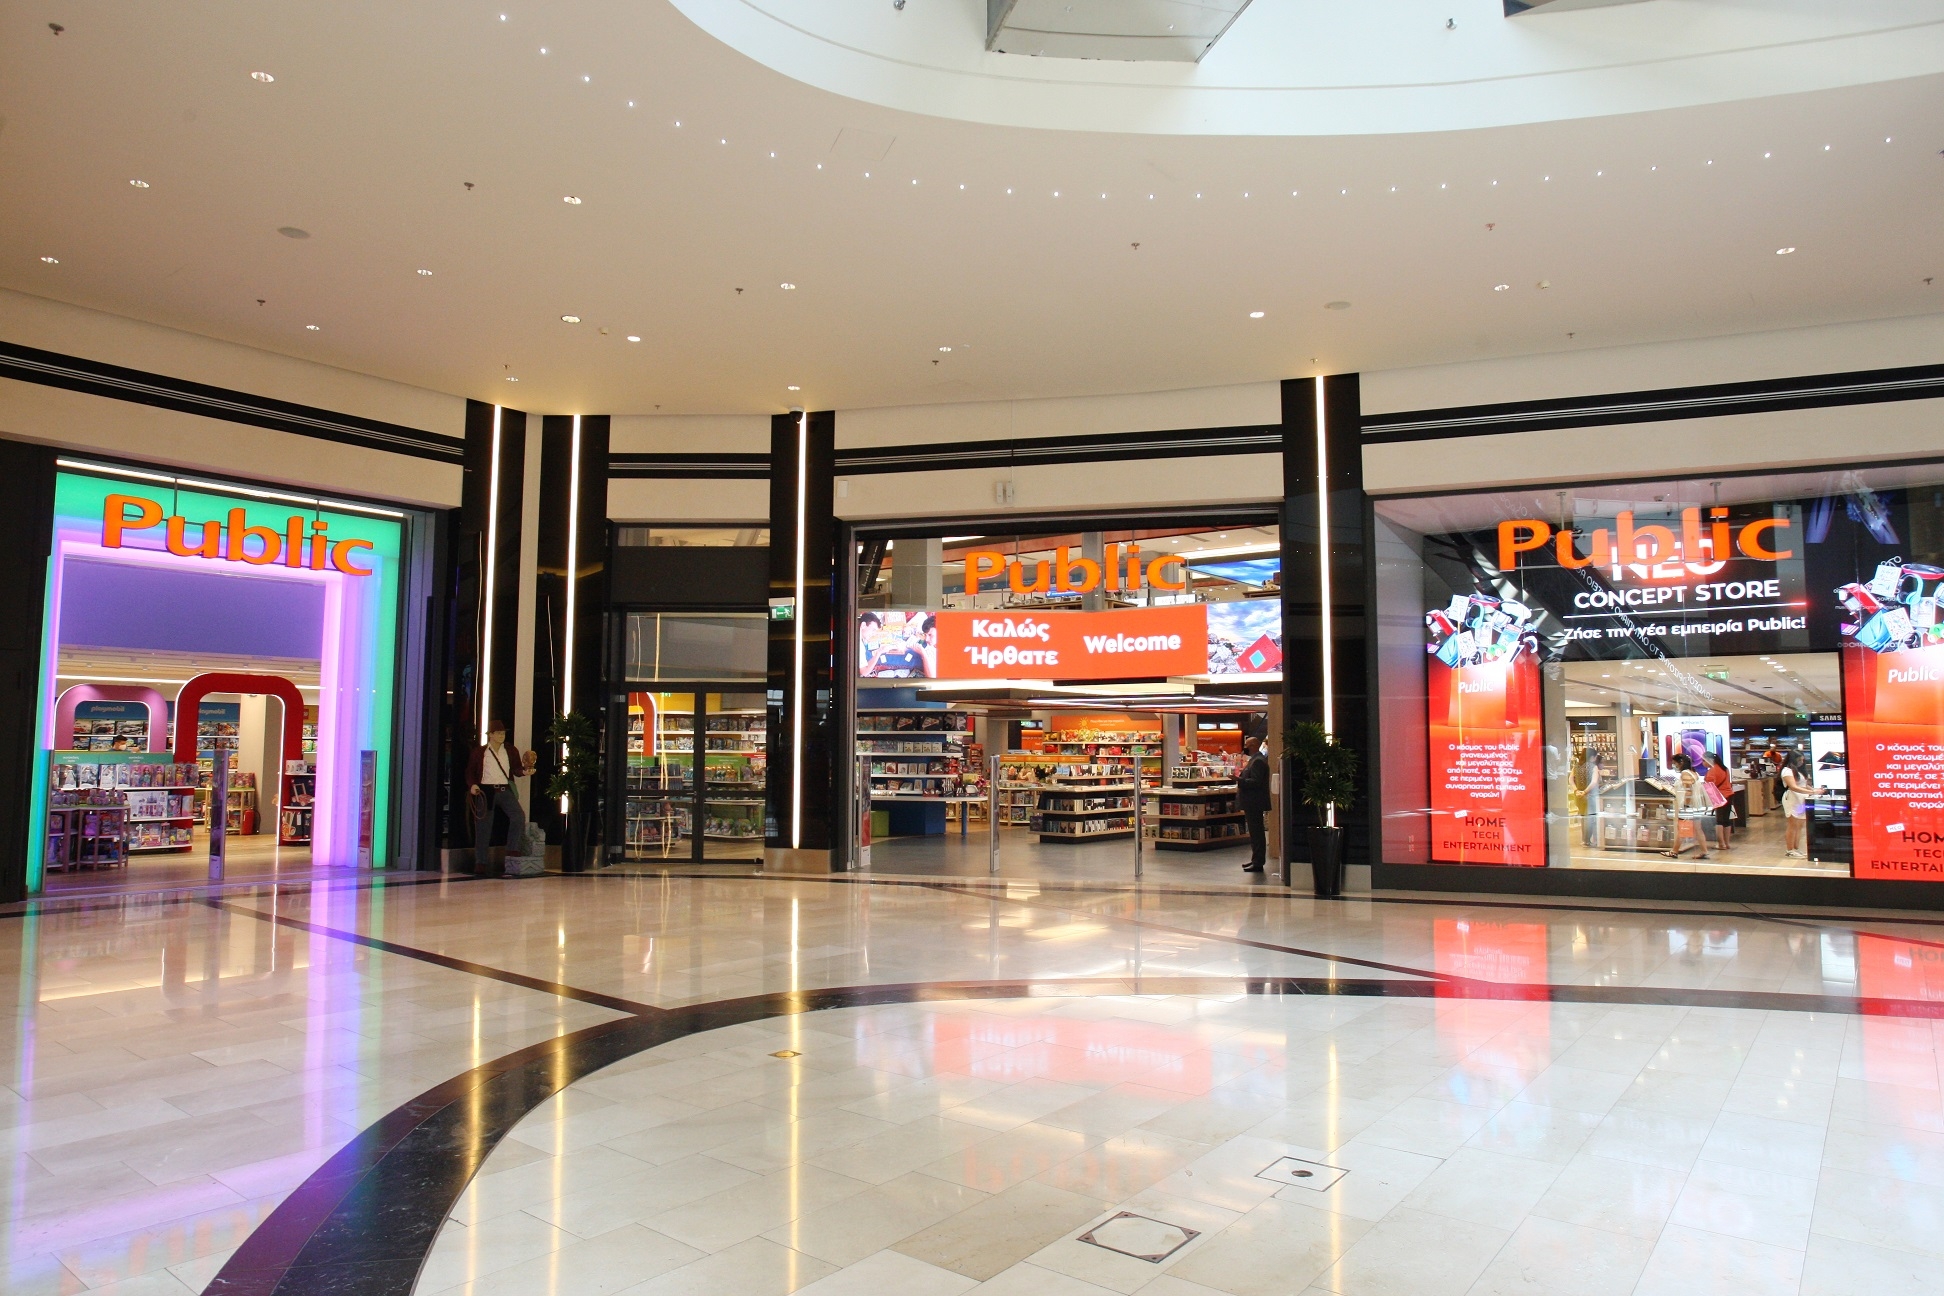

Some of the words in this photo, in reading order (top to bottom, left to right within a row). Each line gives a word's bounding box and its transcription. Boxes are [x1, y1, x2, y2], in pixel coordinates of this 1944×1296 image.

[101, 493, 374, 576] Public
[1497, 507, 1793, 571] Public
[964, 544, 1186, 595] Public
[1574, 586, 1688, 608] CONCEPT
[1695, 579, 1781, 601] STORE
[971, 618, 1050, 642] Καλώς
[1563, 626, 1603, 640] Ζήσε
[1606, 627, 1634, 639] την
[1639, 622, 1667, 637] νέα
[1671, 618, 1743, 637] εμπειρία
[1747, 616, 1807, 632] Public!
[1083, 633, 1182, 654] Welcome
[963, 645, 1059, 669] Ήρθατε
[1888, 667, 1940, 684] Public
[1458, 680, 1495, 694] Public
[1887, 743, 1925, 752] κόσμος
[1896, 772, 1922, 780] ποτέ,
[1893, 782, 1941, 790] περιμένει
[1871, 791, 1943, 799] συναρπαστική
[1465, 816, 1507, 828] HOME
[1472, 830, 1500, 840] TECH
[1443, 840, 1532, 853] ENTERTAINMENT
